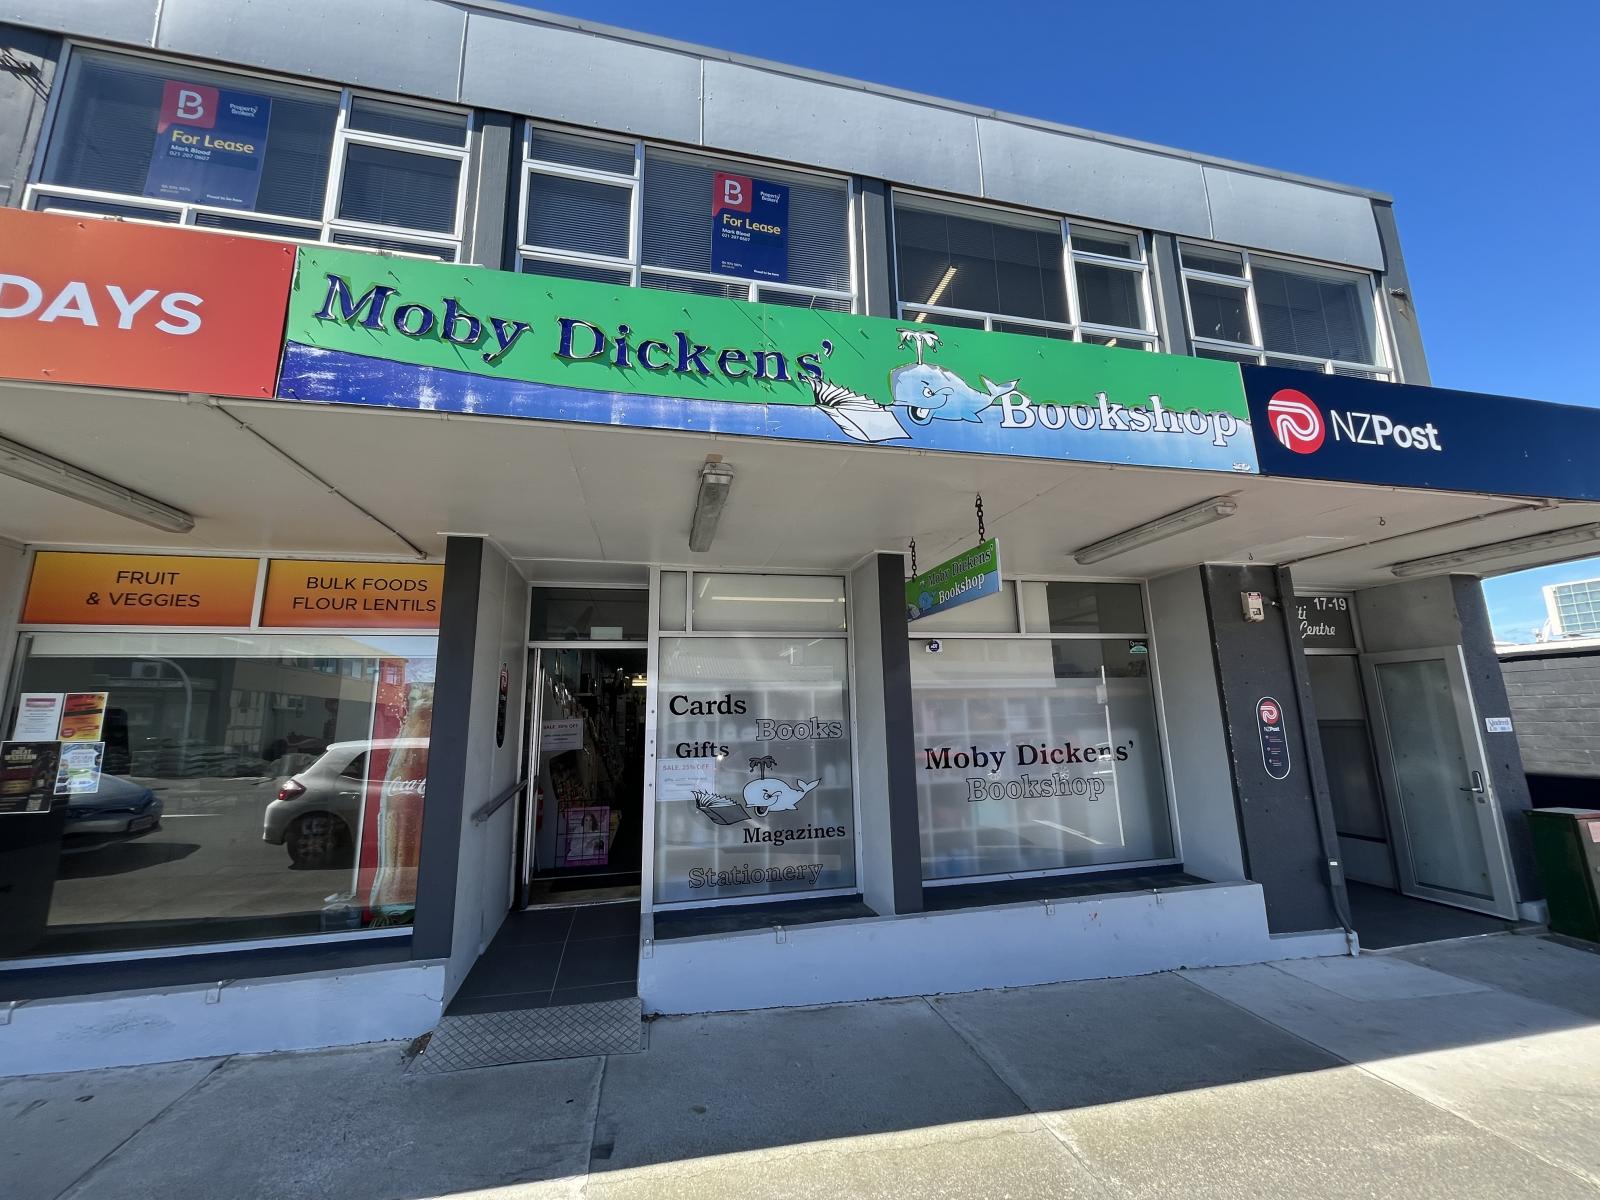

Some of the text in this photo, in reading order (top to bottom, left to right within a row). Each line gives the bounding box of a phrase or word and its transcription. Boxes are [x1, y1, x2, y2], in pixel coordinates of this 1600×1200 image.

[229, 103, 257, 114] Property
[170, 145, 211, 156] Mark Blood
[171, 129, 255, 154] For Lease
[760, 191, 781, 201] Property
[723, 213, 781, 235] For Lease
[0, 273, 204, 336] DAYS
[314, 273, 833, 382] Moby Dickens'
[1000, 390, 1238, 447] Bookshop
[1330, 409, 1442, 451] NZPost
[928, 543, 994, 587] Moby Dickens'
[116, 570, 181, 586] FRUIT
[306, 576, 428, 592] BULK FOODS
[938, 572, 985, 605] Bookshop
[85, 591, 201, 608] & VEGGIES
[292, 596, 437, 612] FLOUR LENTILS
[1313, 597, 1347, 611] 17-19
[1300, 620, 1336, 639] Centre
[669, 693, 747, 716] Cards
[755, 716, 843, 741] Books
[675, 741, 730, 758] Gifts
[924, 739, 1134, 774] Moby Dickens'
[965, 772, 1105, 802] Bookshop
[743, 824, 846, 846] Magazines
[688, 862, 824, 889] Stationery
